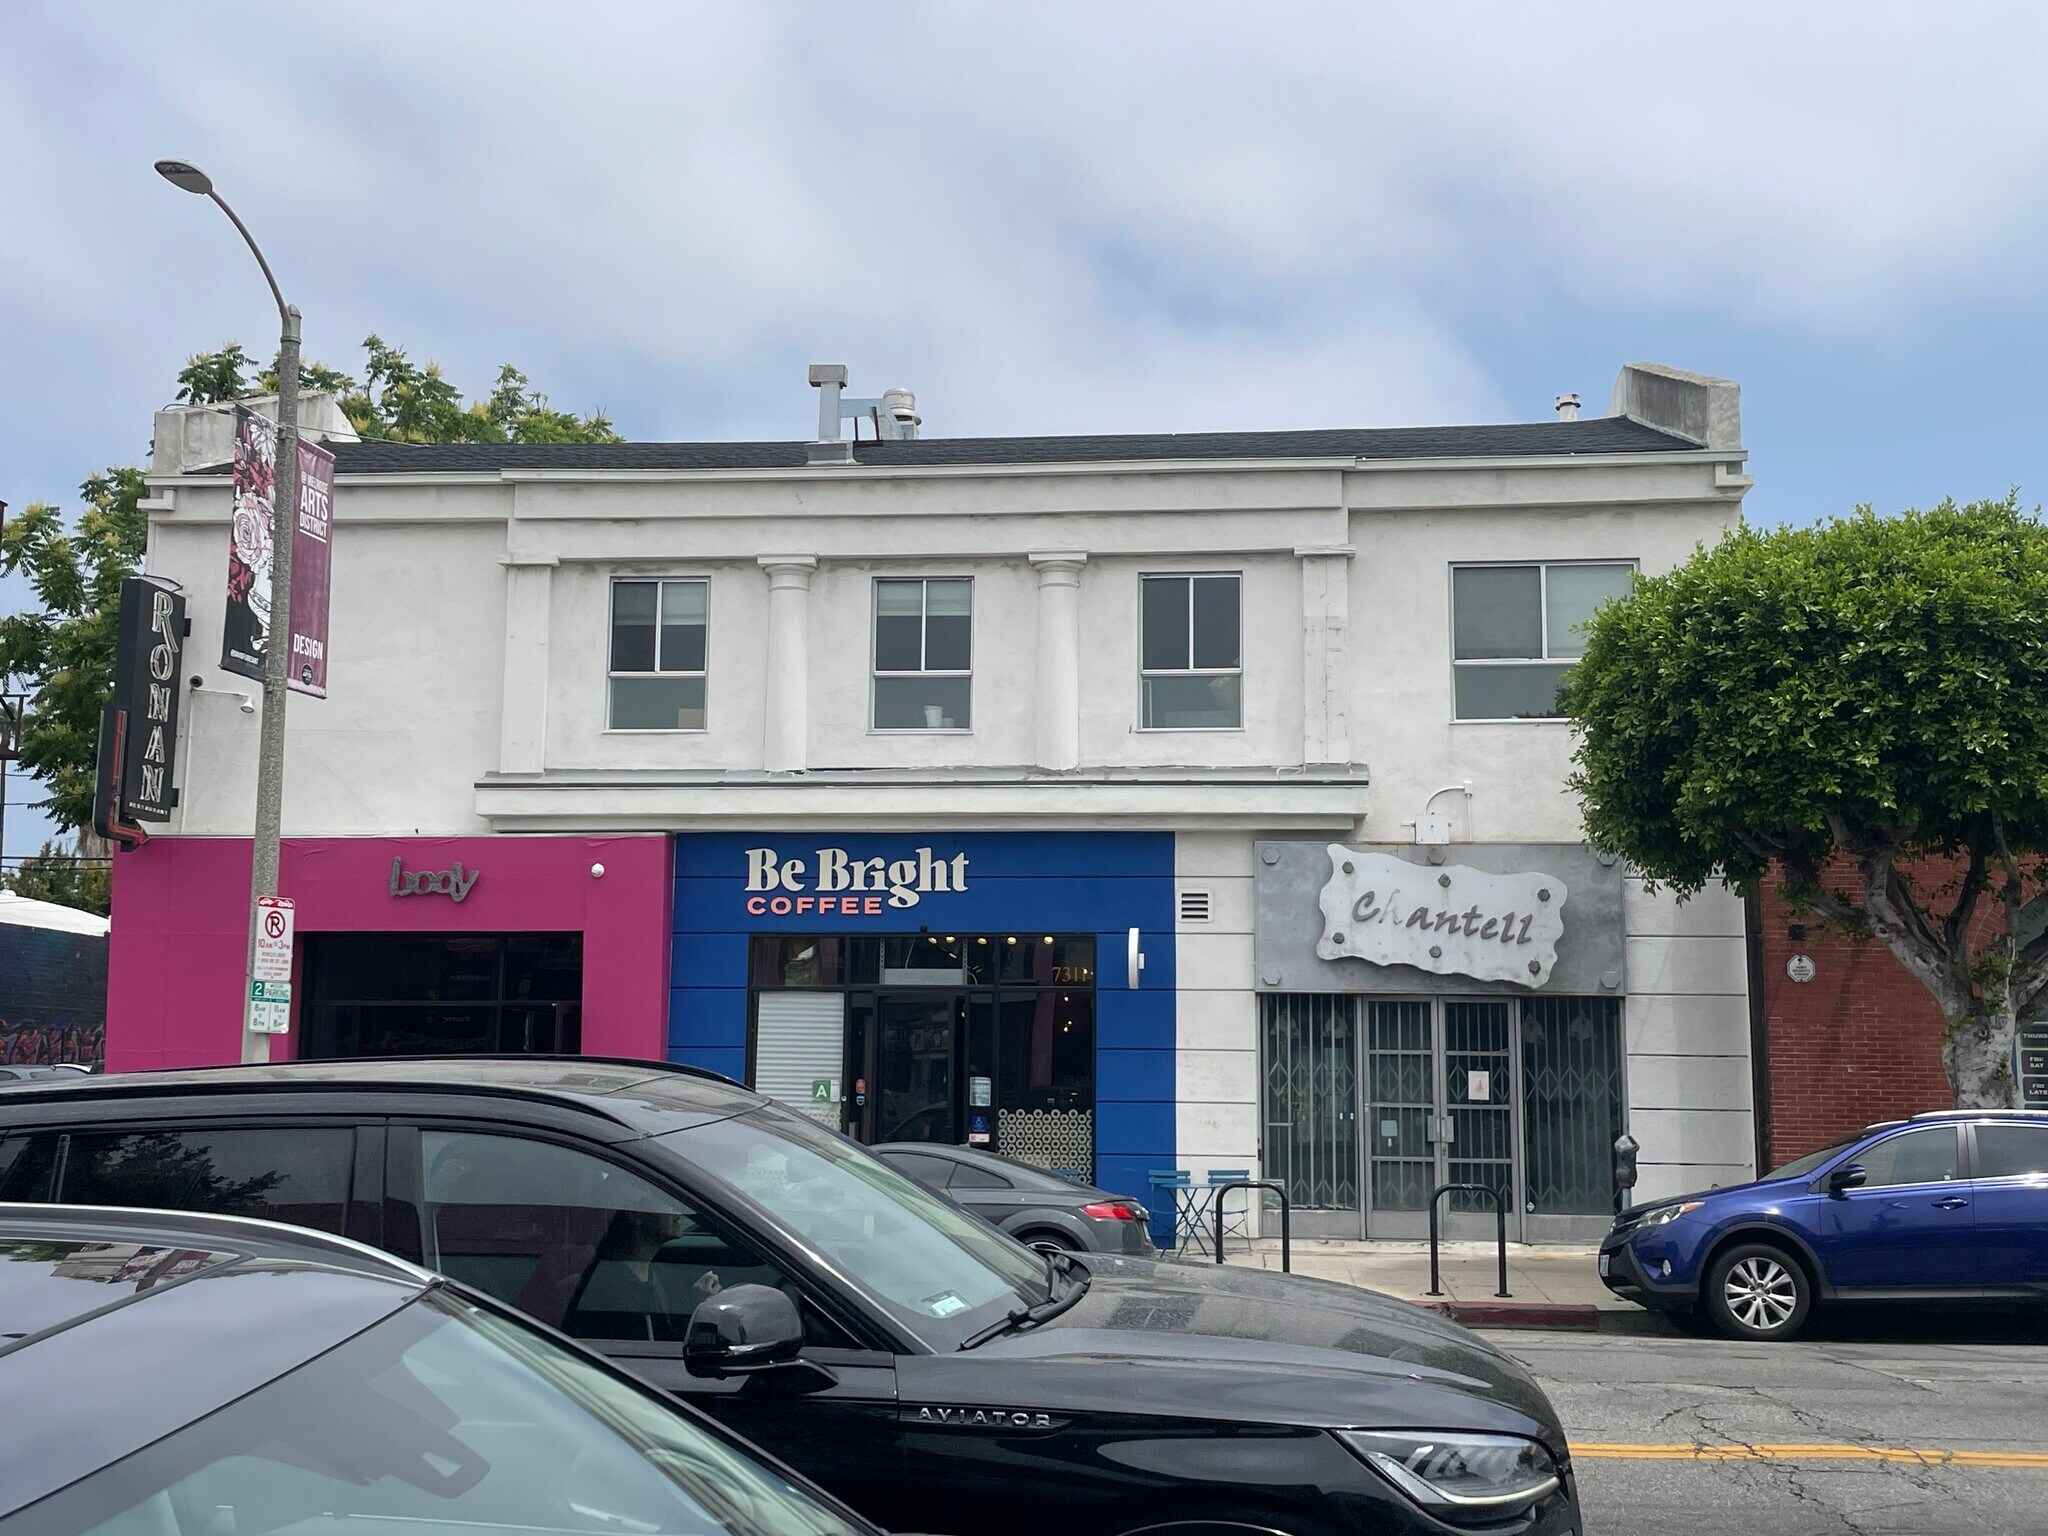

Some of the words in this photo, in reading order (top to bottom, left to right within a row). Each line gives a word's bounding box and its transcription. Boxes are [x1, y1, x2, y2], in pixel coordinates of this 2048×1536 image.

[300, 485, 329, 521] ARTS
[299, 511, 328, 538] DISTRICT
[293, 633, 324, 661] DESIGN
[140, 590, 179, 803] RONAN
[128, 801, 169, 816] RESTAURANT
[744, 848, 806, 892] Be
[814, 847, 970, 908] Bright
[746, 897, 883, 915] COFFEE
[1352, 890, 1533, 945] Chantell
[255, 982, 263, 996] 2
[815, 1084, 828, 1098] A
[918, 1407, 1051, 1427] AVIATOR
